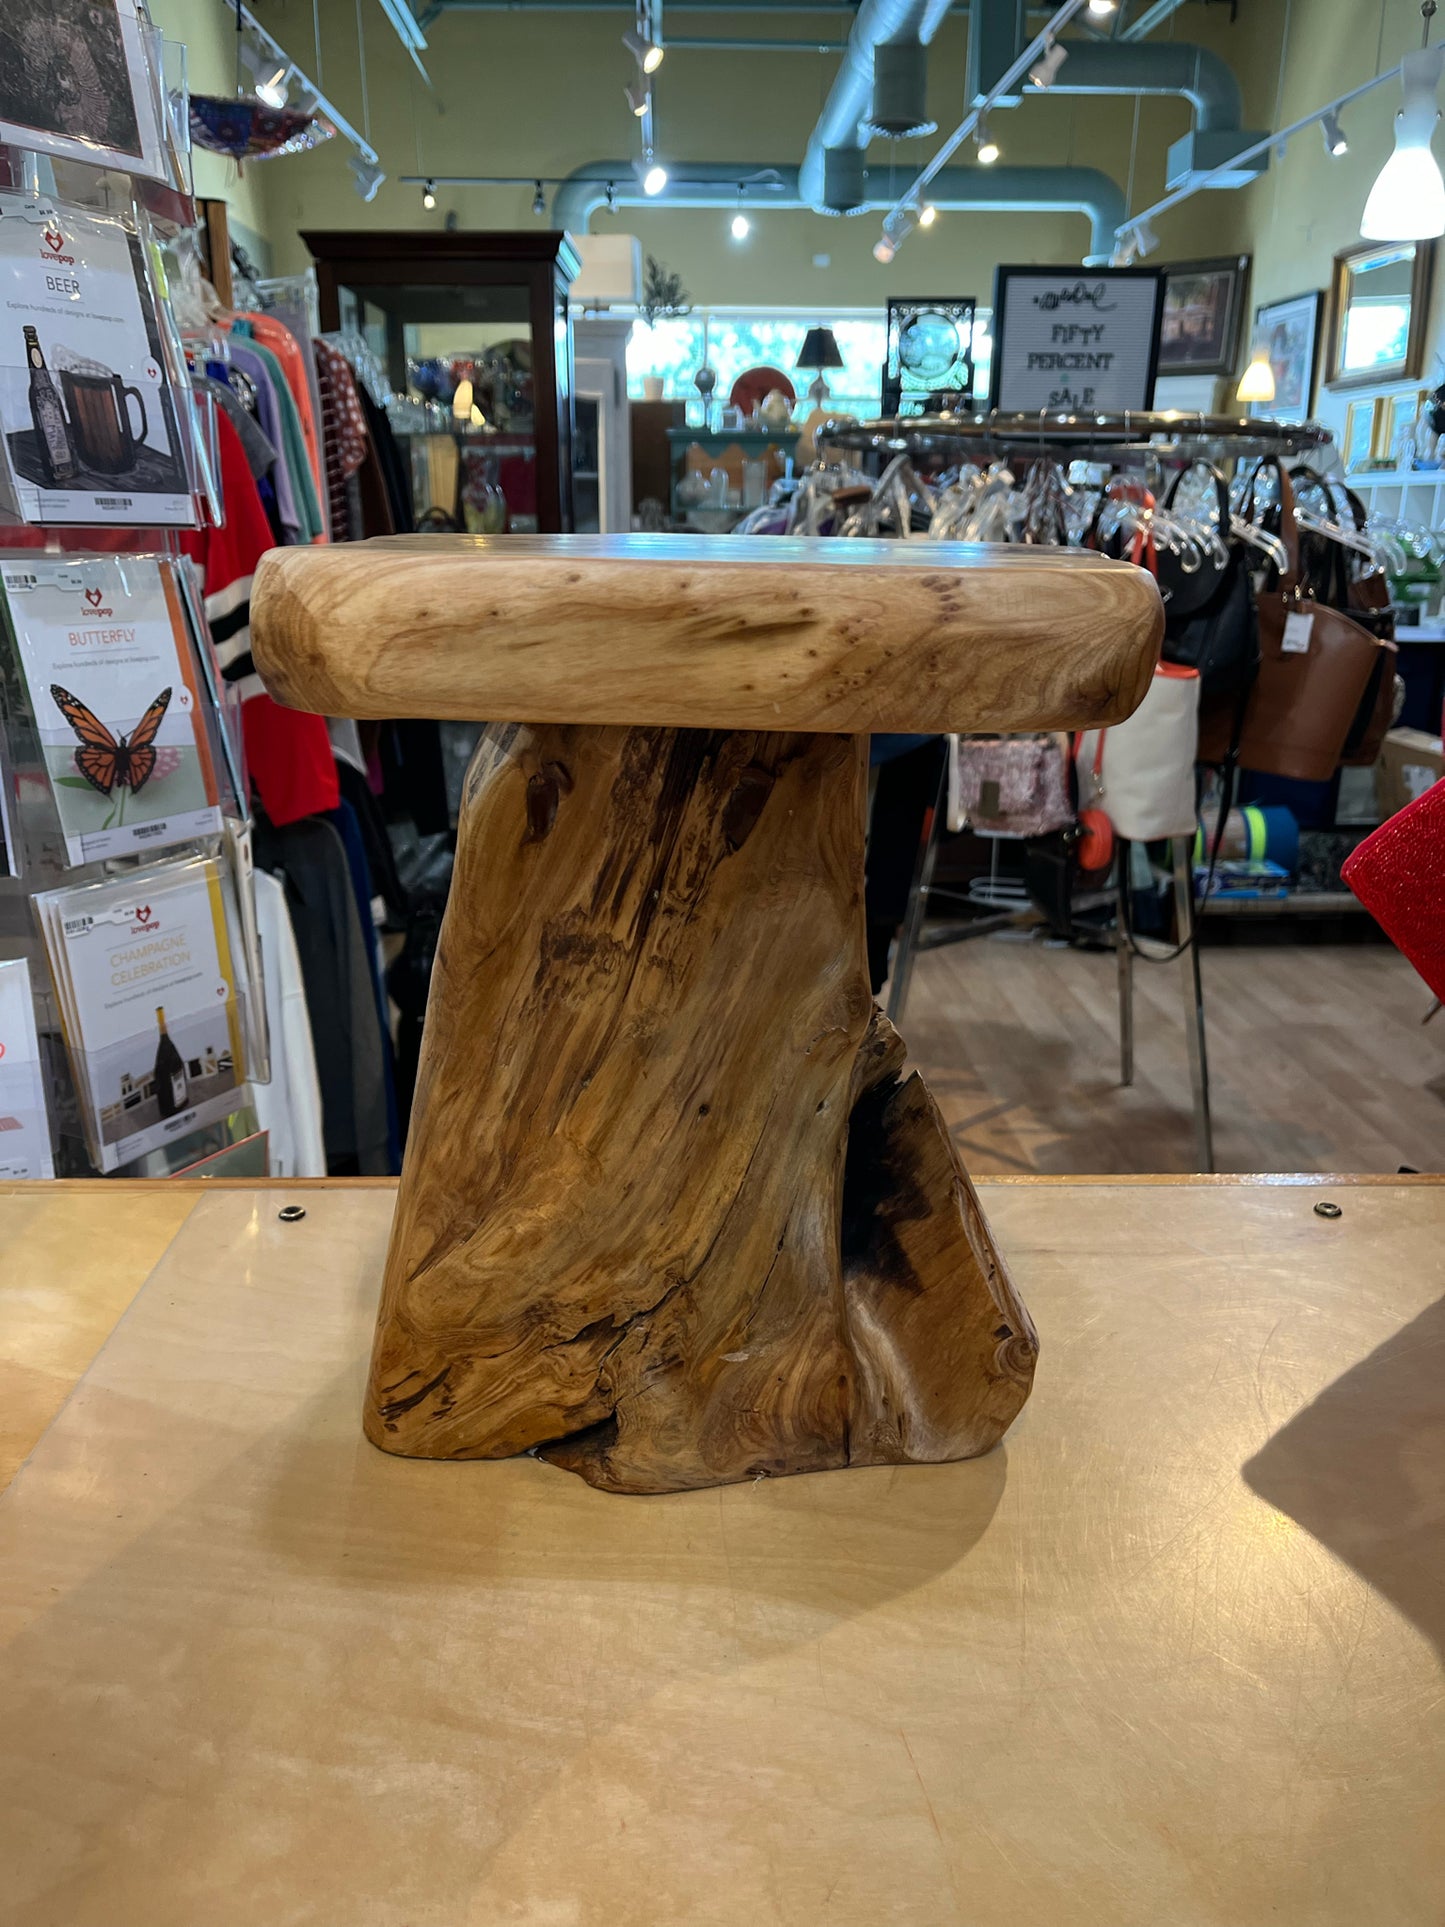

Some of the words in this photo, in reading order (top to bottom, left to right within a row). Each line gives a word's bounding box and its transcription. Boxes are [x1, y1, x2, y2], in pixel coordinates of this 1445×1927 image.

[39, 248, 75, 266] lovepop
[46, 276, 81, 294] BEER
[1051, 323, 1105, 346] FIFTY
[1027, 352, 1115, 371] PERCENT
[1049, 386, 1096, 413] SALE
[80, 606, 113, 618] lovepop
[68, 628, 136, 646] BUTTERFLY
[130, 920, 160, 935] lovepop
[110, 933, 187, 968] CHAMPAGNE
[111, 950, 192, 986] CELEBRATION
